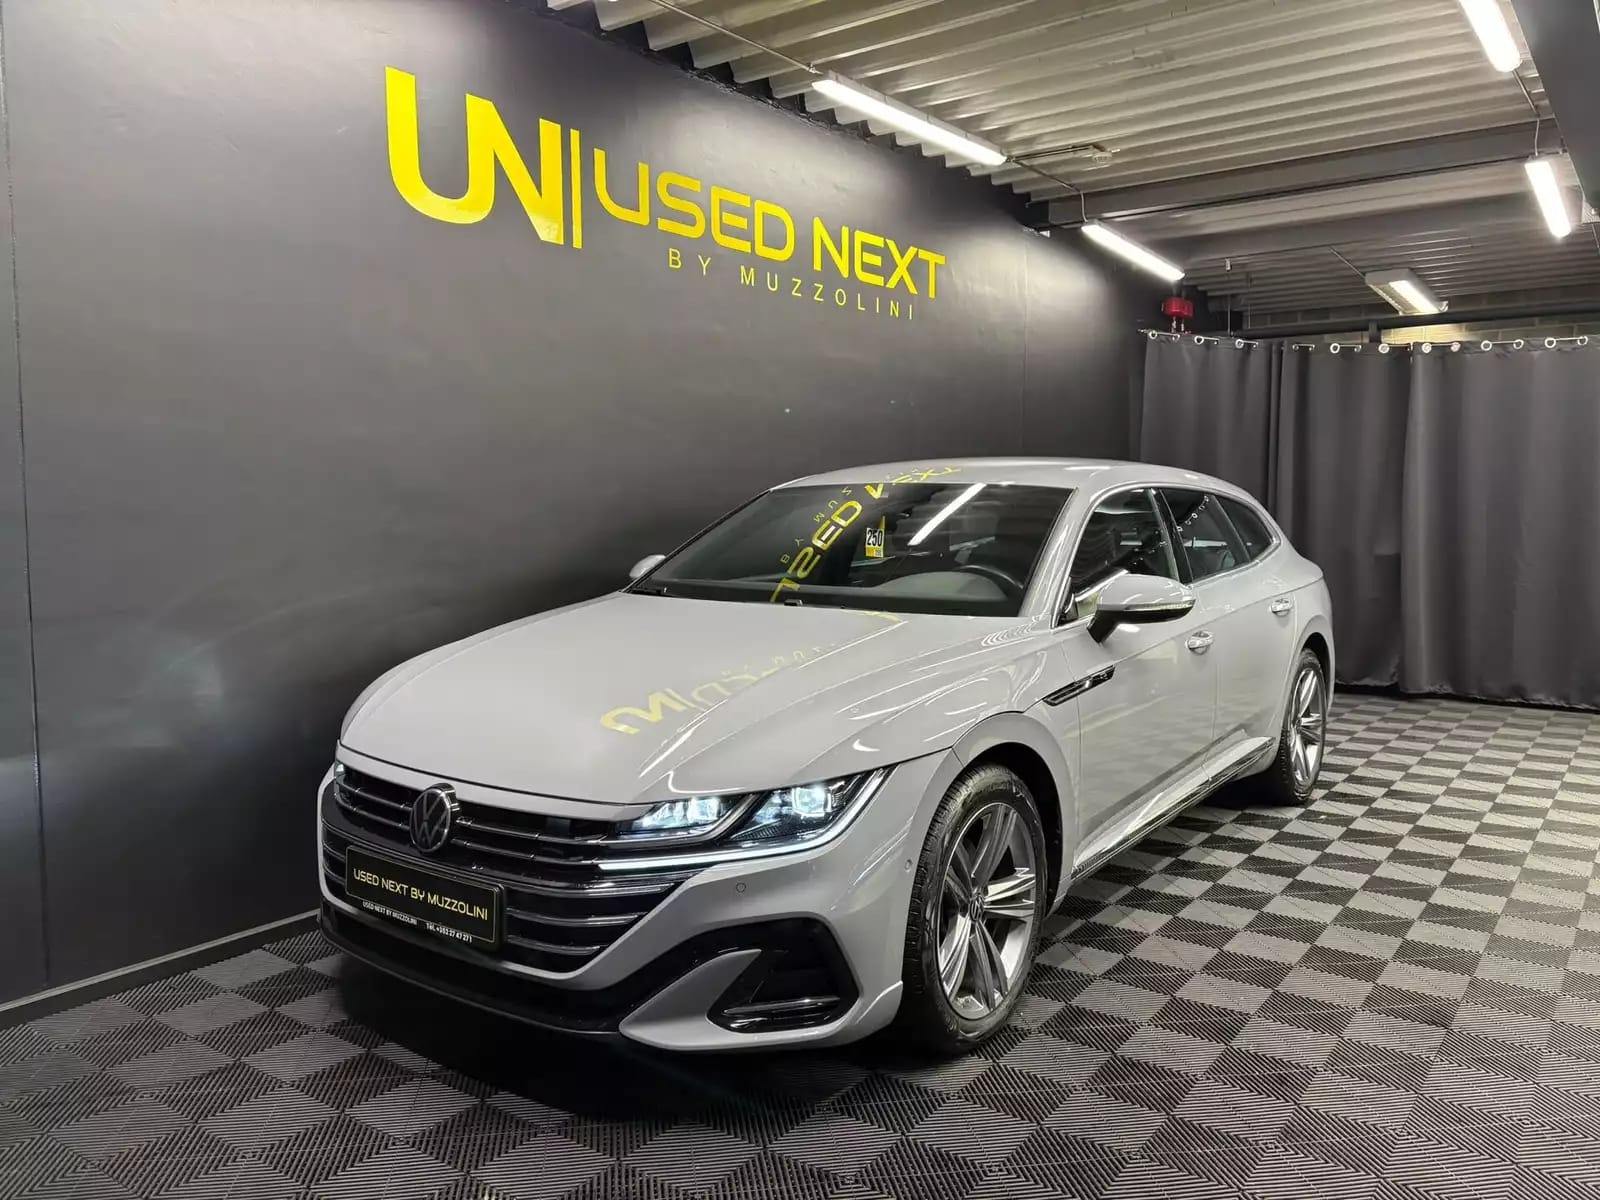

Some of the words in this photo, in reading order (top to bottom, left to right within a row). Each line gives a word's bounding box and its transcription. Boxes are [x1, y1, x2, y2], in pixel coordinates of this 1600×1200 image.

[593, 147, 795, 262] USED
[812, 216, 946, 300] NEXT
[668, 248, 711, 276] BY
[740, 265, 914, 320] MUZZOLINI
[867, 529, 883, 547] 250
[353, 867, 379, 886] USED
[381, 877, 408, 896] NEXT
[410, 887, 425, 901] BY
[427, 892, 488, 920] MUZZOLINI
[362, 900, 374, 910] USED
[374, 905, 386, 914] NEXT
[386, 909, 392, 917] BY
